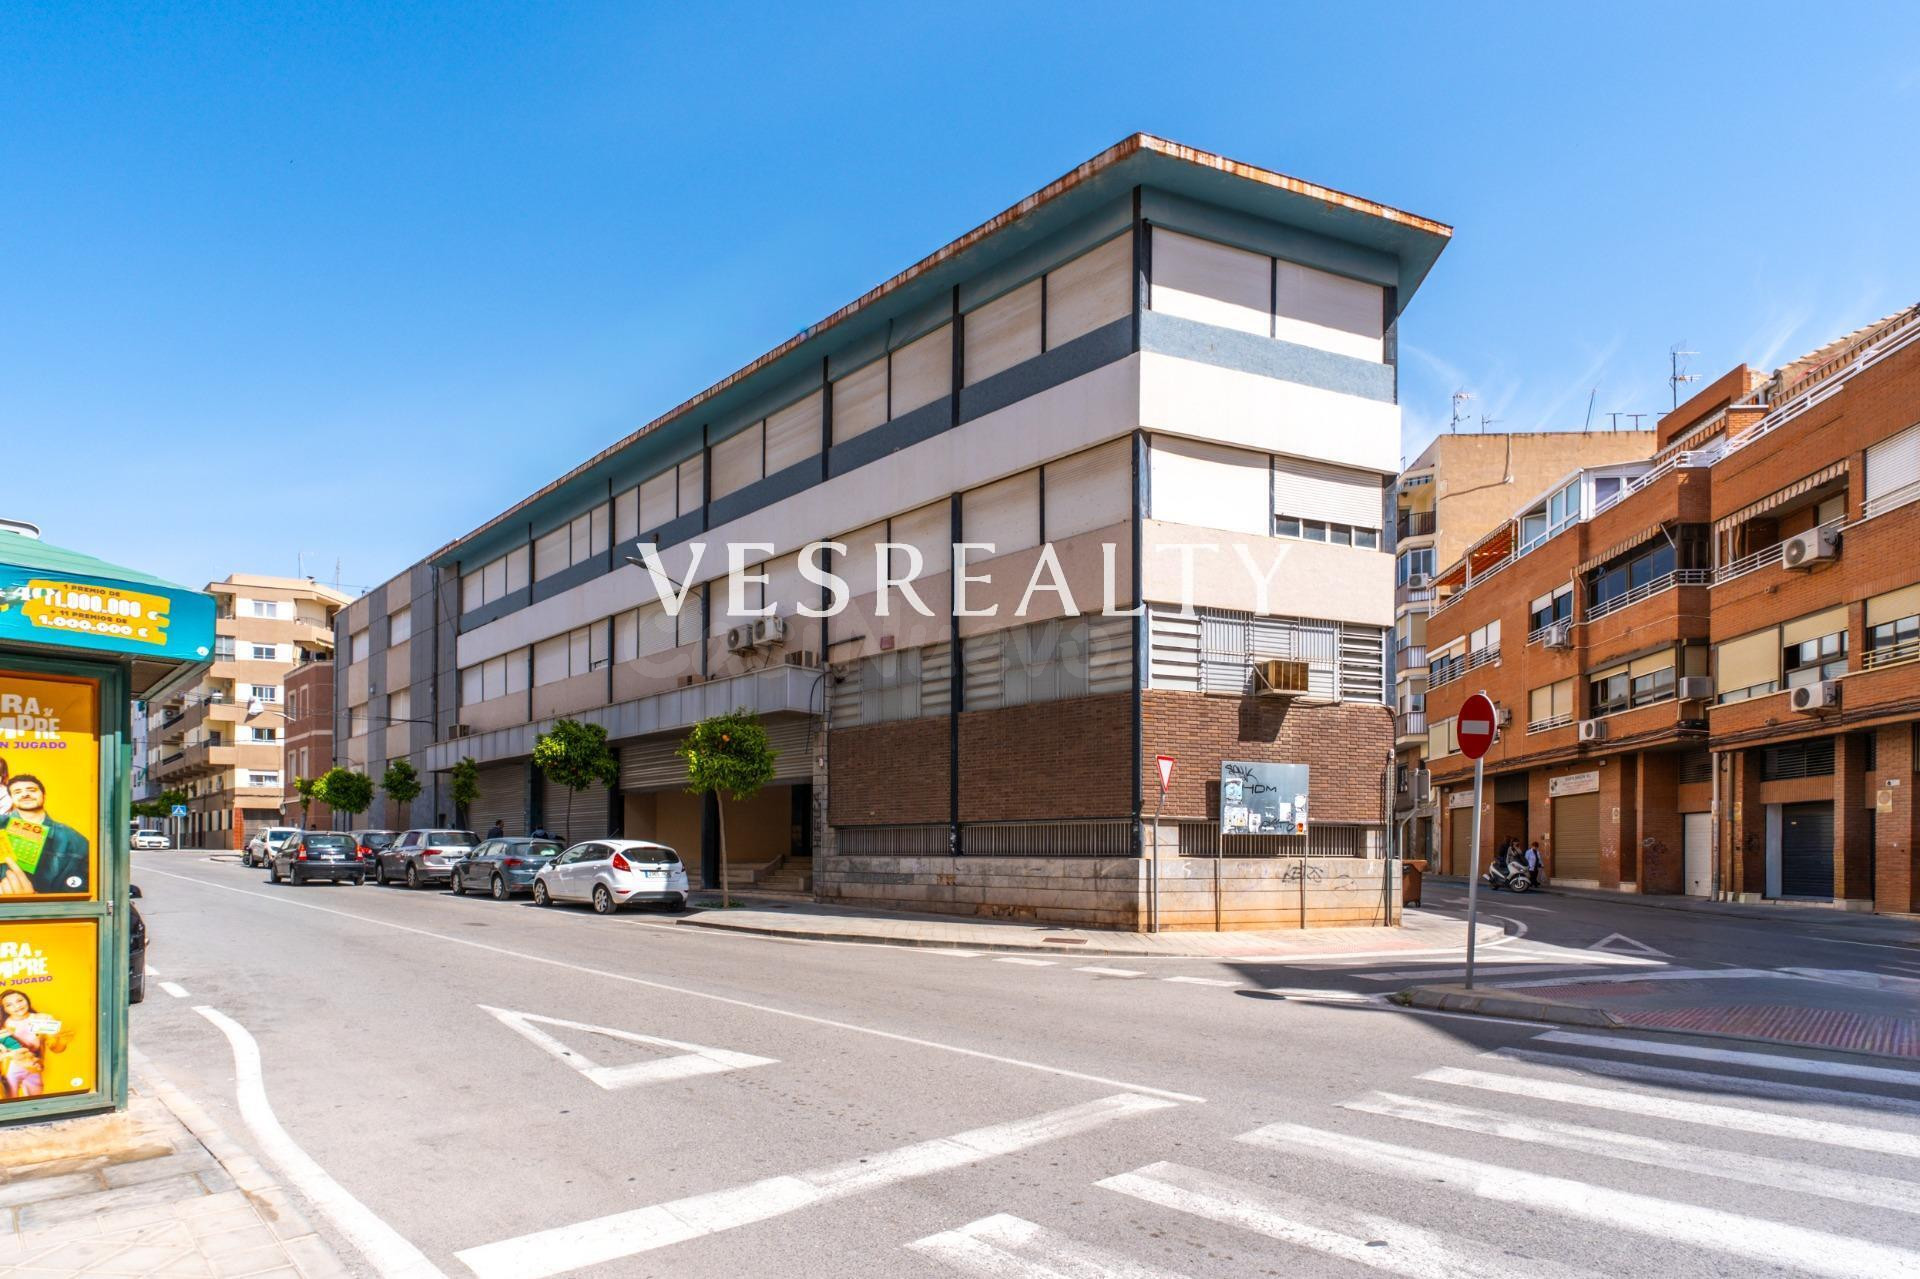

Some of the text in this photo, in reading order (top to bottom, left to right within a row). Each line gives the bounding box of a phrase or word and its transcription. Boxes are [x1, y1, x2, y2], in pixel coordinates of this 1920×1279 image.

[71, 585, 106, 596] PREMIO
[72, 612, 113, 623] PREMIOS
[38, 614, 133, 636] 1.000.000
[14, 741, 67, 749] JUGADO
[11, 975, 54, 986] JUGADO
